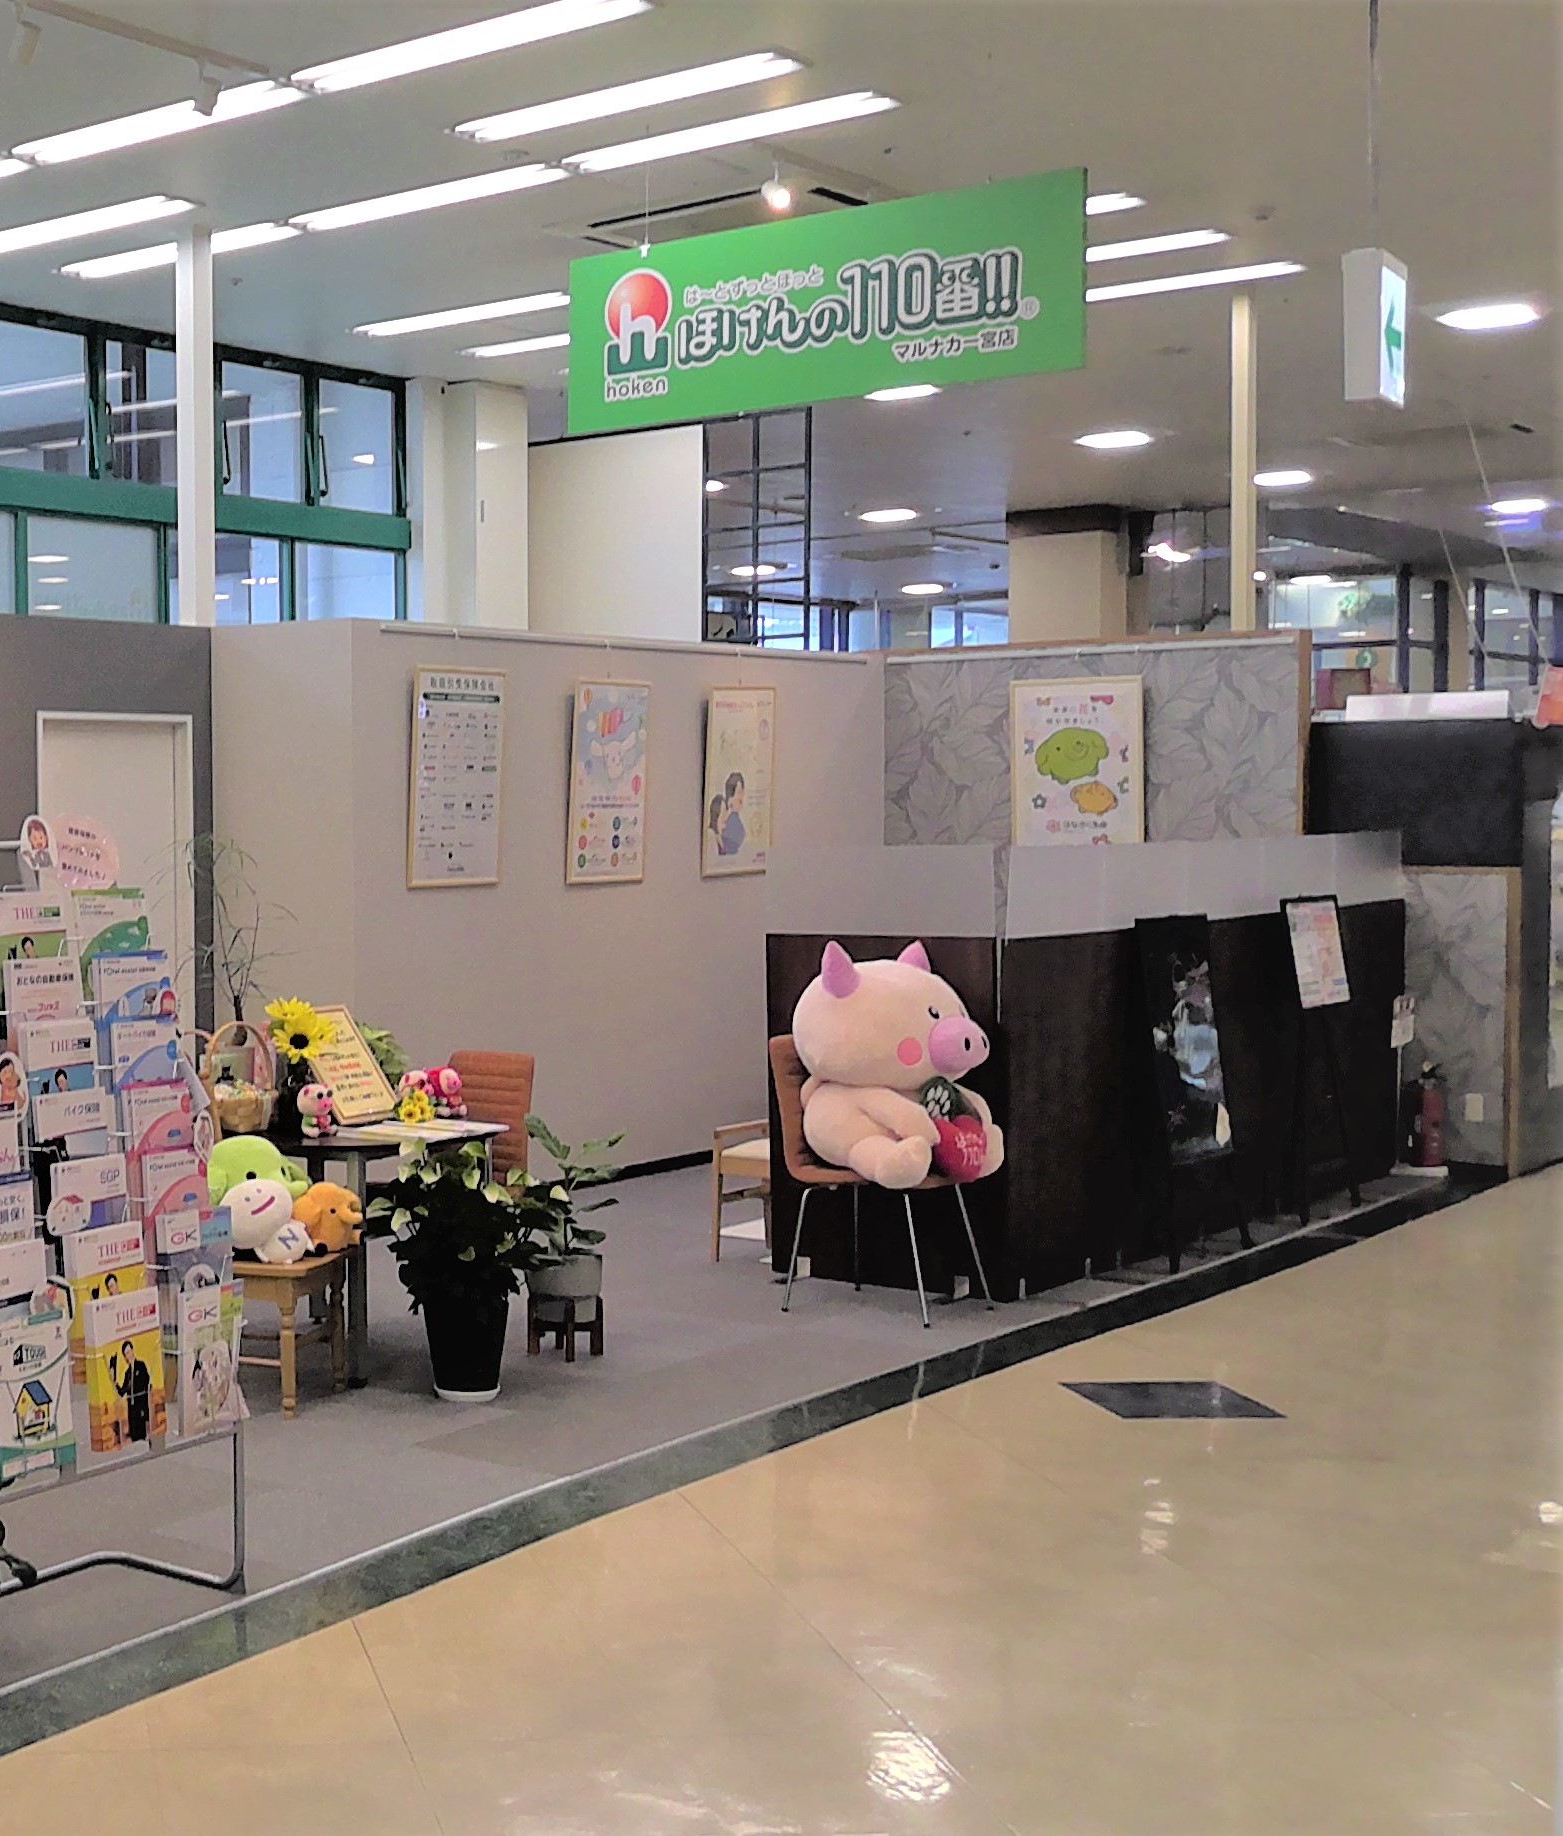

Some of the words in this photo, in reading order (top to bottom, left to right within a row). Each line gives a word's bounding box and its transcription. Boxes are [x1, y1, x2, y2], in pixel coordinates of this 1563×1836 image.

[677, 248, 1023, 369] ほけんの110番!!
[891, 328, 1018, 362] マルナカ一宮店
[606, 377, 667, 400] hoken
[14, 906, 36, 921] THE
[16, 973, 75, 986] おとなの自動車保険
[50, 1040, 74, 1054] THE
[64, 1102, 101, 1117] バイク保険
[169, 1228, 198, 1246] GK
[98, 1244, 122, 1258] THE
[116, 1308, 136, 1326] THE
[187, 1304, 218, 1323] GK
